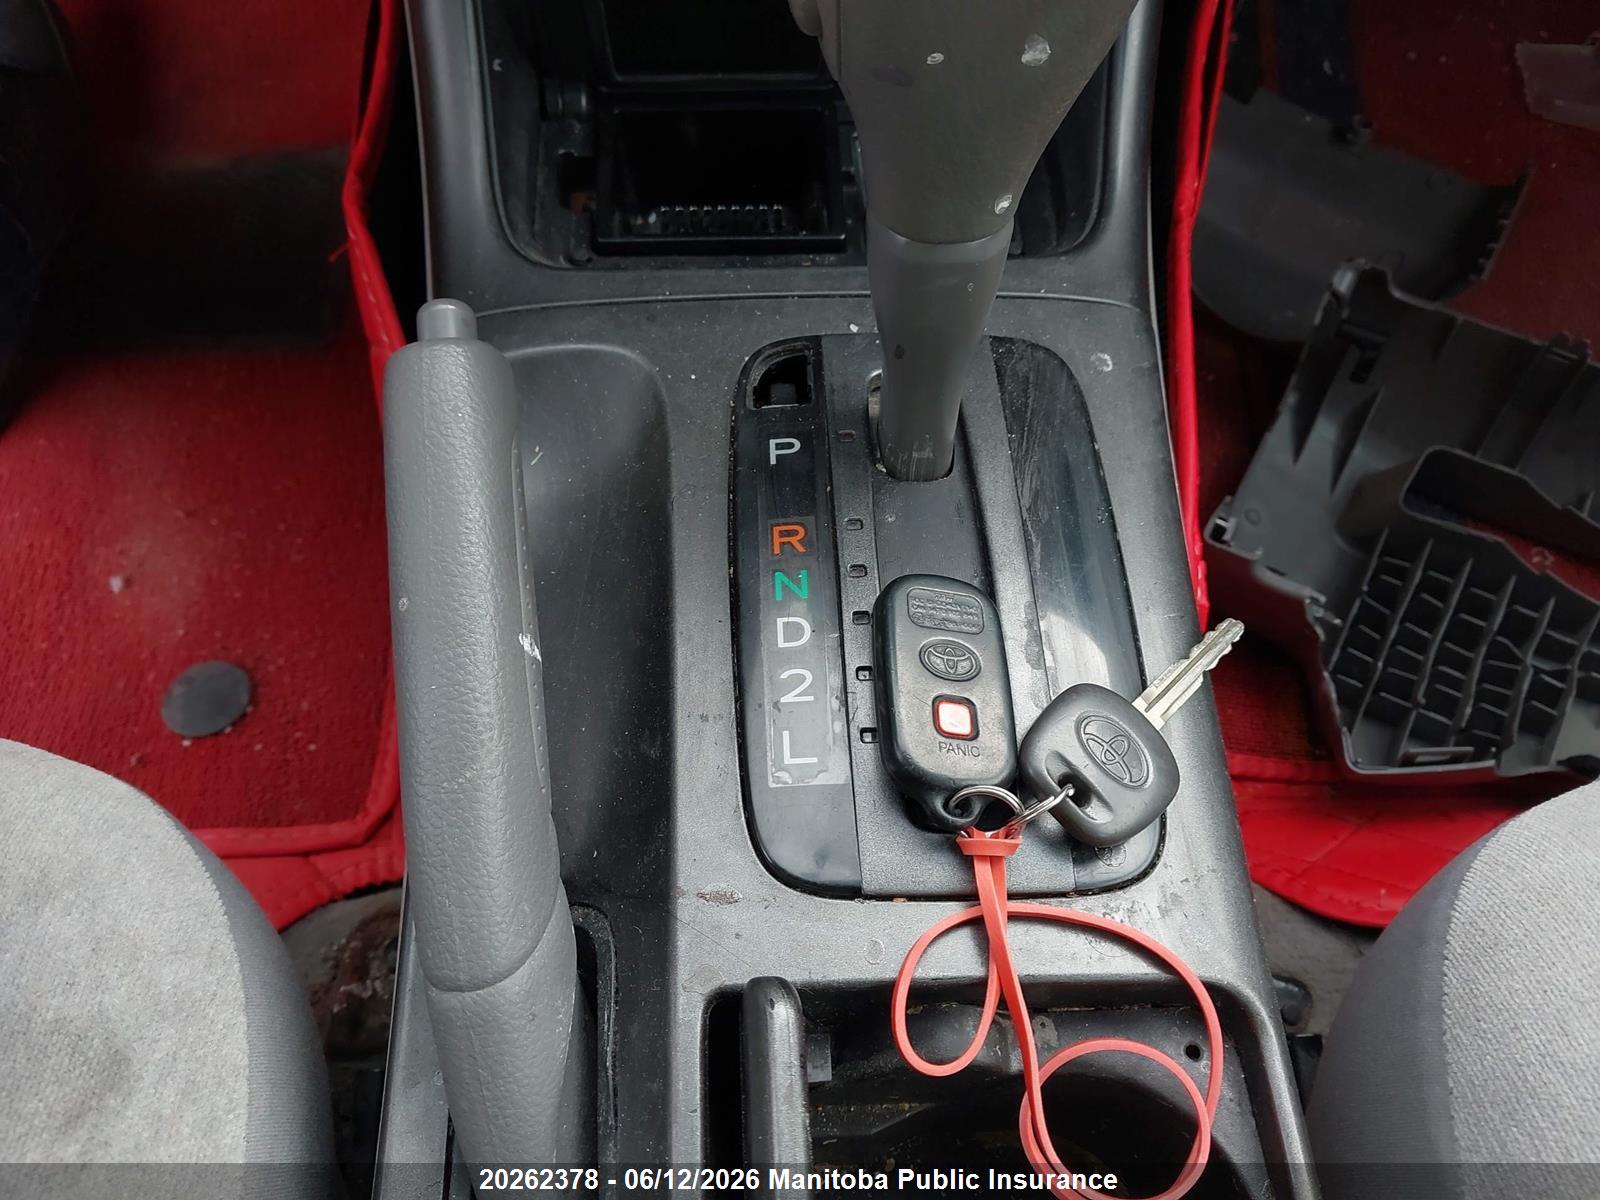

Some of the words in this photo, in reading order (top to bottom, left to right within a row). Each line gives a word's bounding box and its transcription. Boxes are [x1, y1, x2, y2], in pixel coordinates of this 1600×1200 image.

[769, 437, 801, 465] P
[772, 524, 807, 556] R
[774, 569, 809, 601] N
[776, 616, 812, 648] D
[778, 668, 815, 703] 2
[782, 730, 818, 765] L
[938, 741, 980, 757] PANIC
